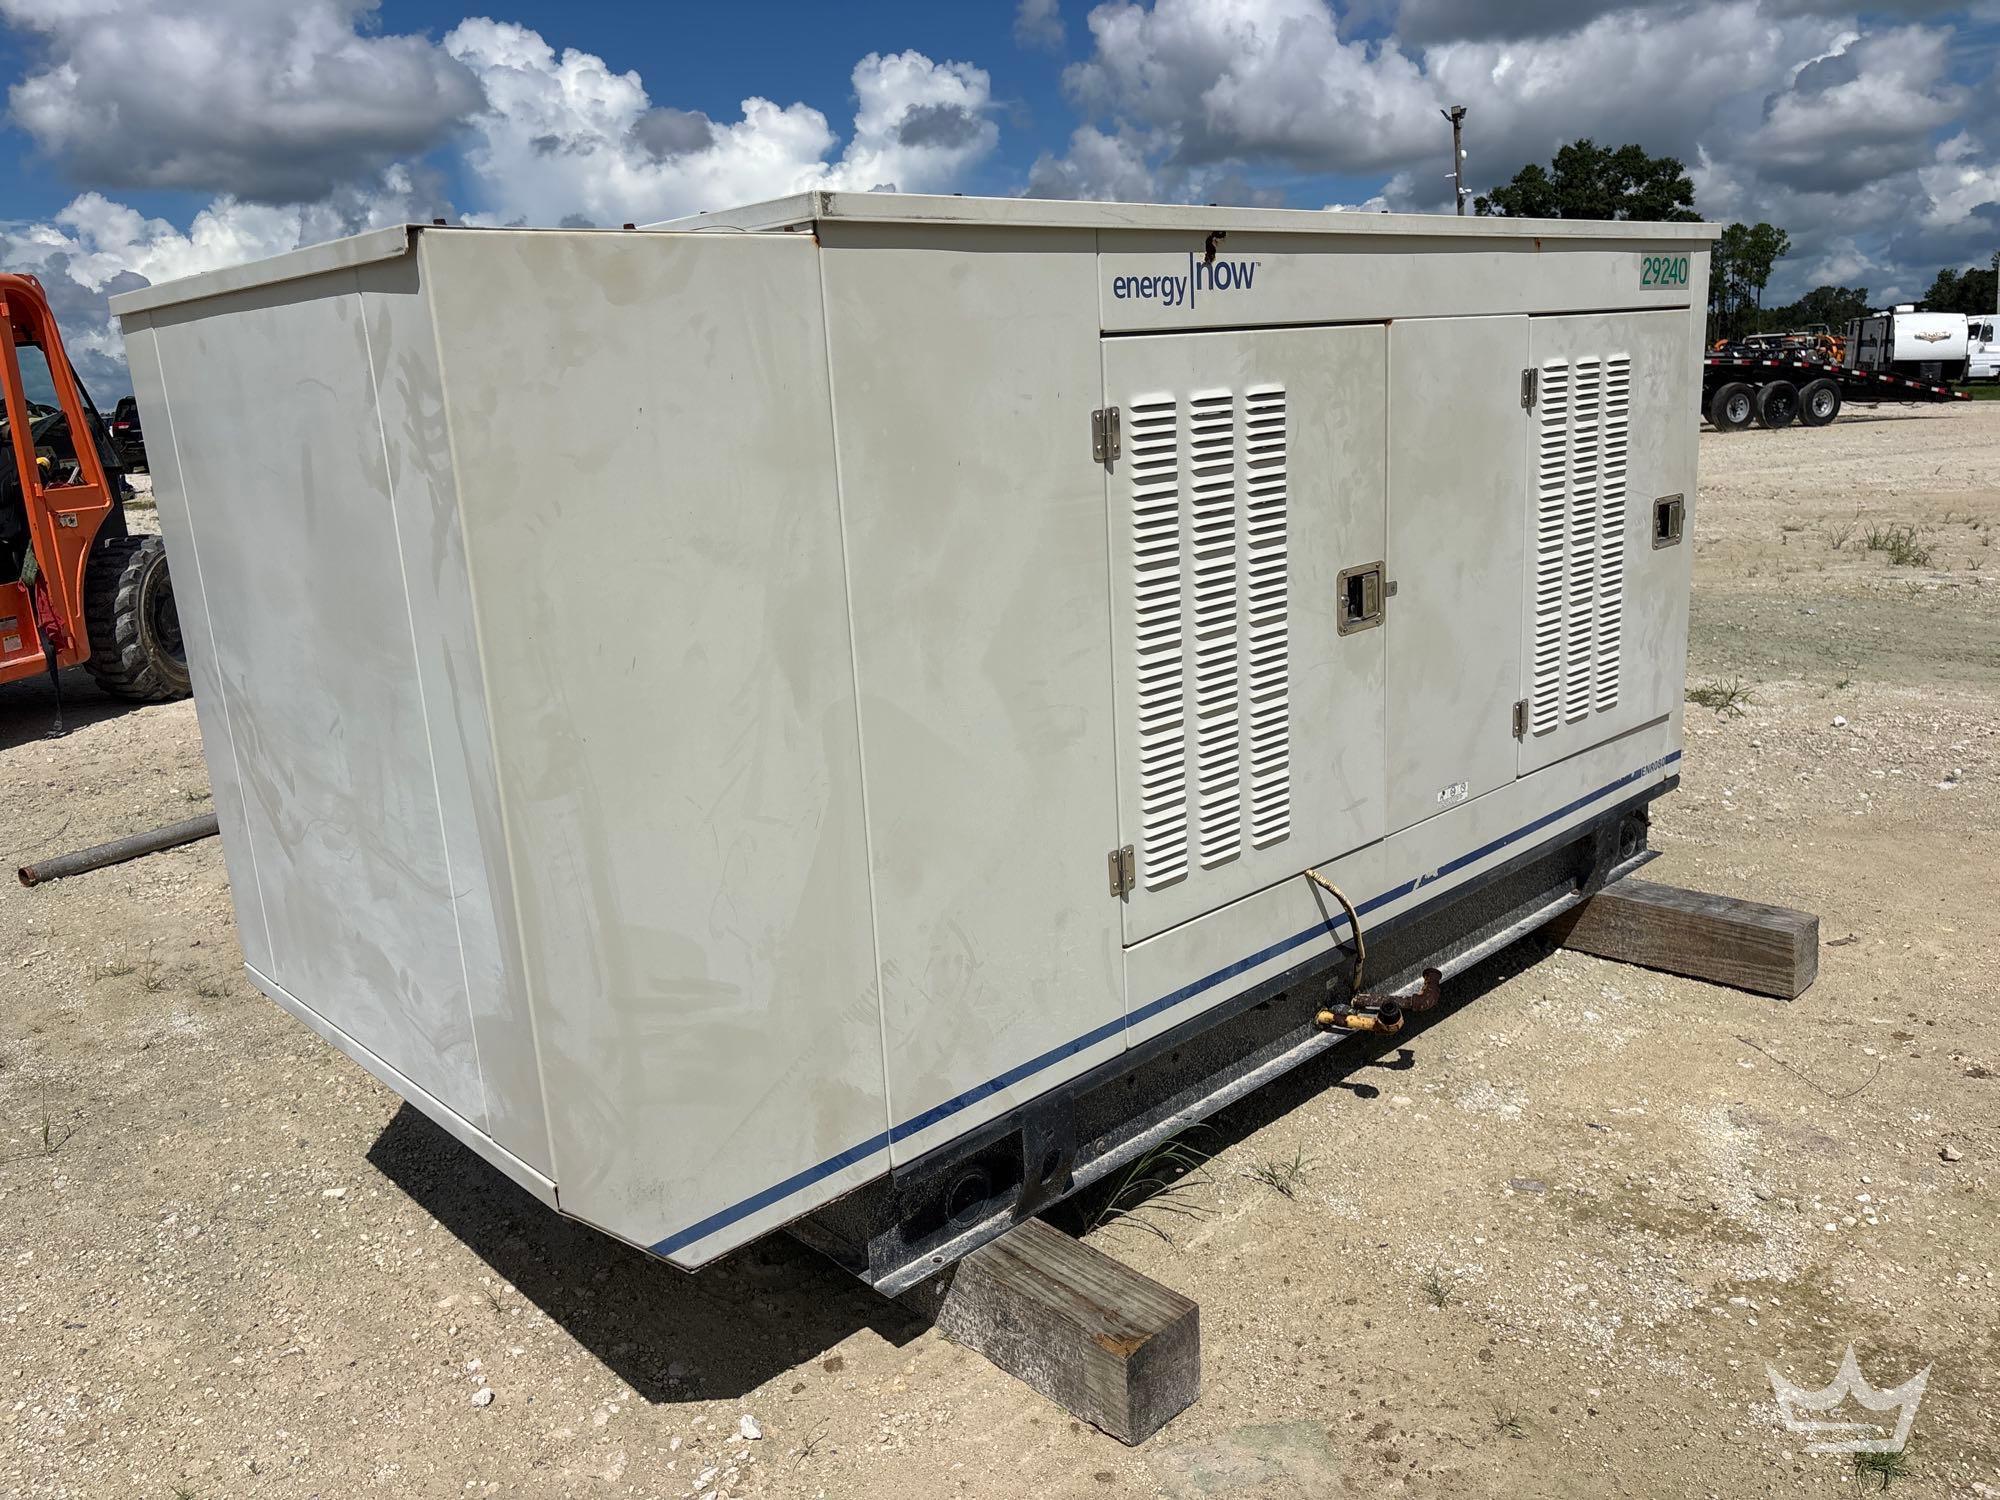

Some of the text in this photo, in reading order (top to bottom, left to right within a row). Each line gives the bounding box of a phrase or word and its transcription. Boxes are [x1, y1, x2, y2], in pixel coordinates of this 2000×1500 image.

[1113, 275, 1187, 306] energy
[1196, 261, 1255, 290] now
[1642, 257, 1688, 285] 29240
